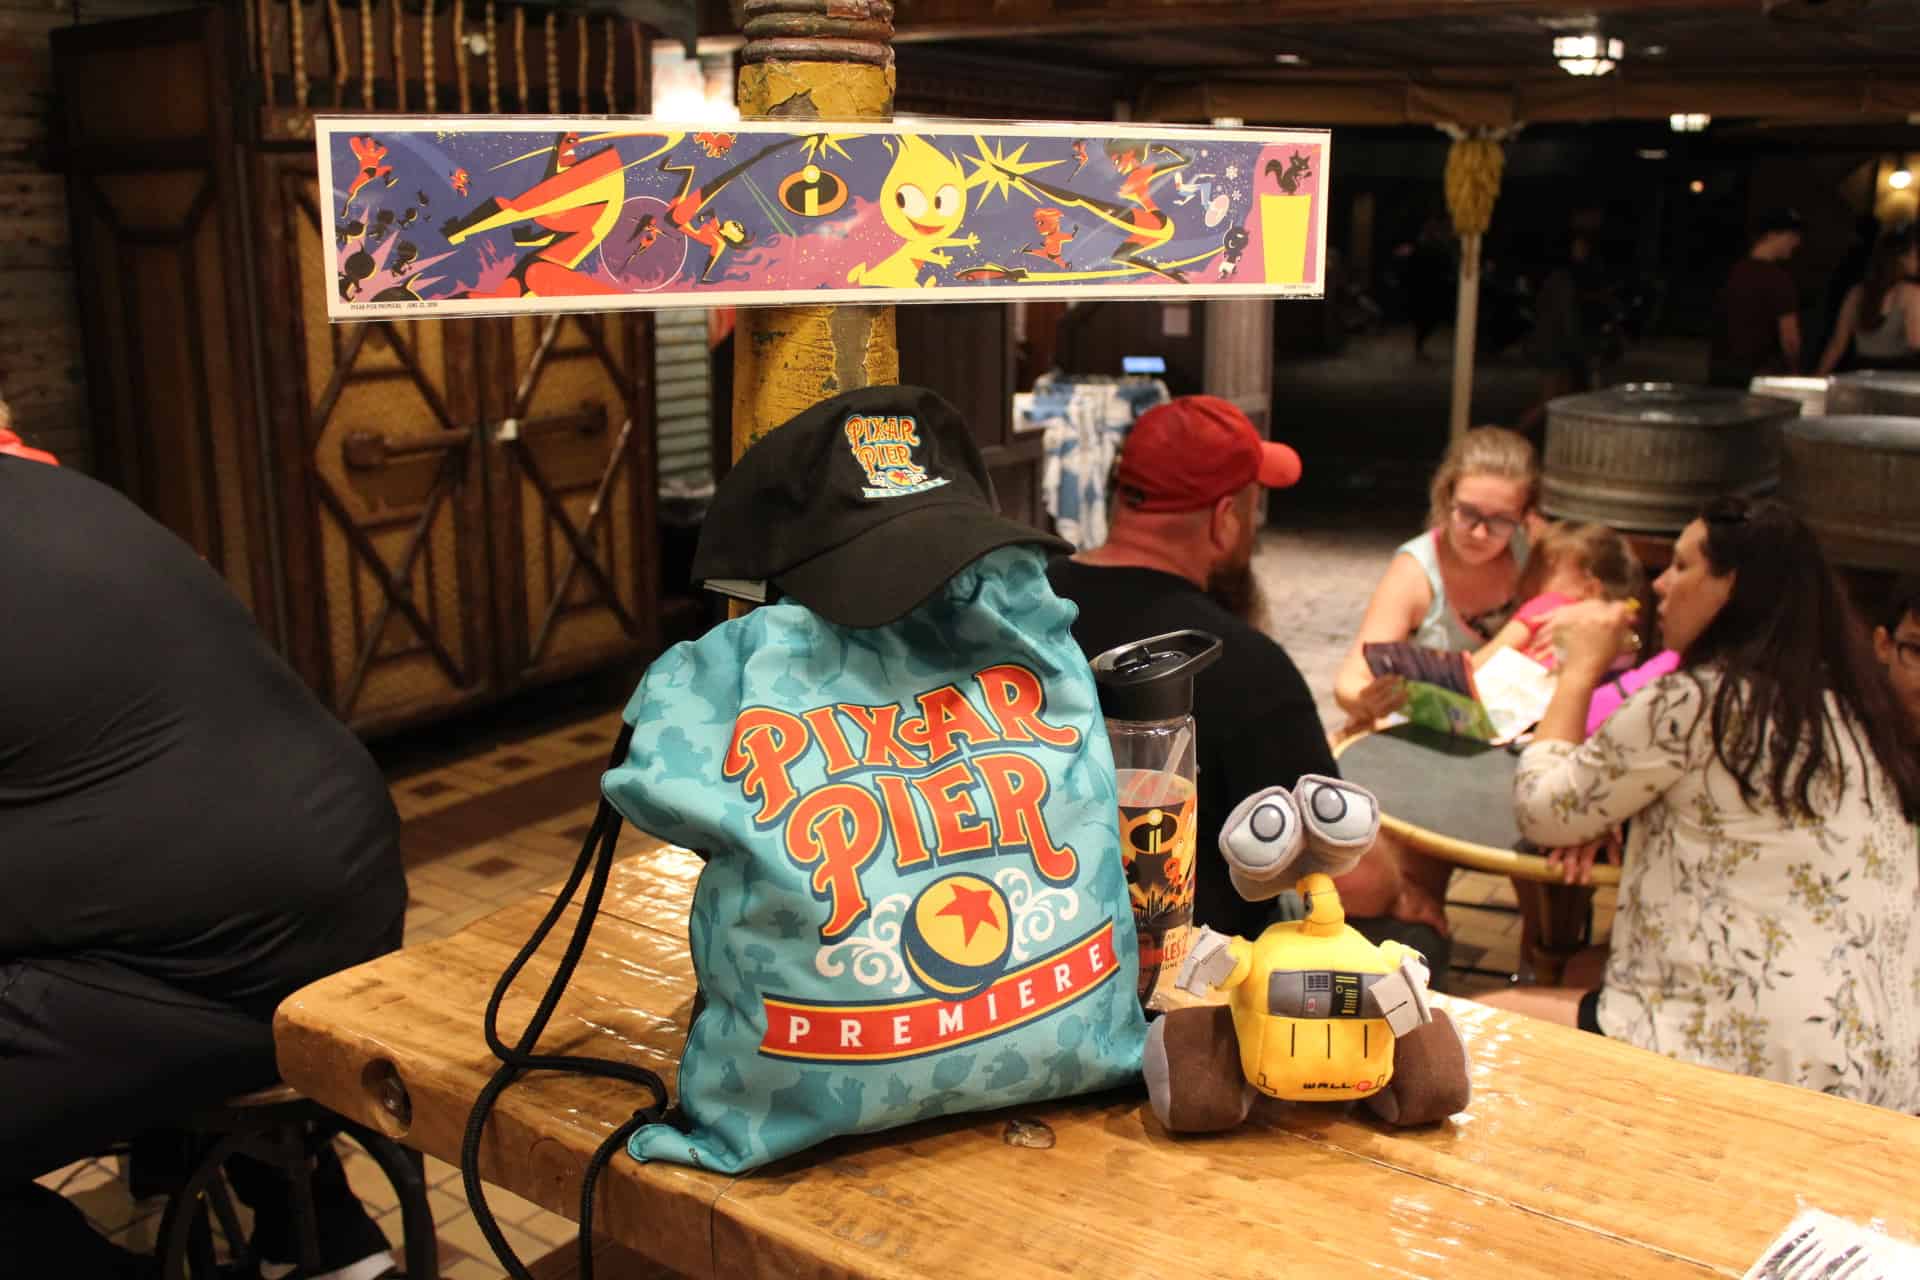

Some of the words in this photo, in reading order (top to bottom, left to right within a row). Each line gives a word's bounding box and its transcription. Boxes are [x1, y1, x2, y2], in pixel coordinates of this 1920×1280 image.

[845, 415, 920, 454] PIXAR
[857, 444, 925, 479] PIER
[722, 664, 1079, 825] PIXAR
[784, 752, 1079, 939] PIER
[788, 942, 1104, 1047] PREMIERE
